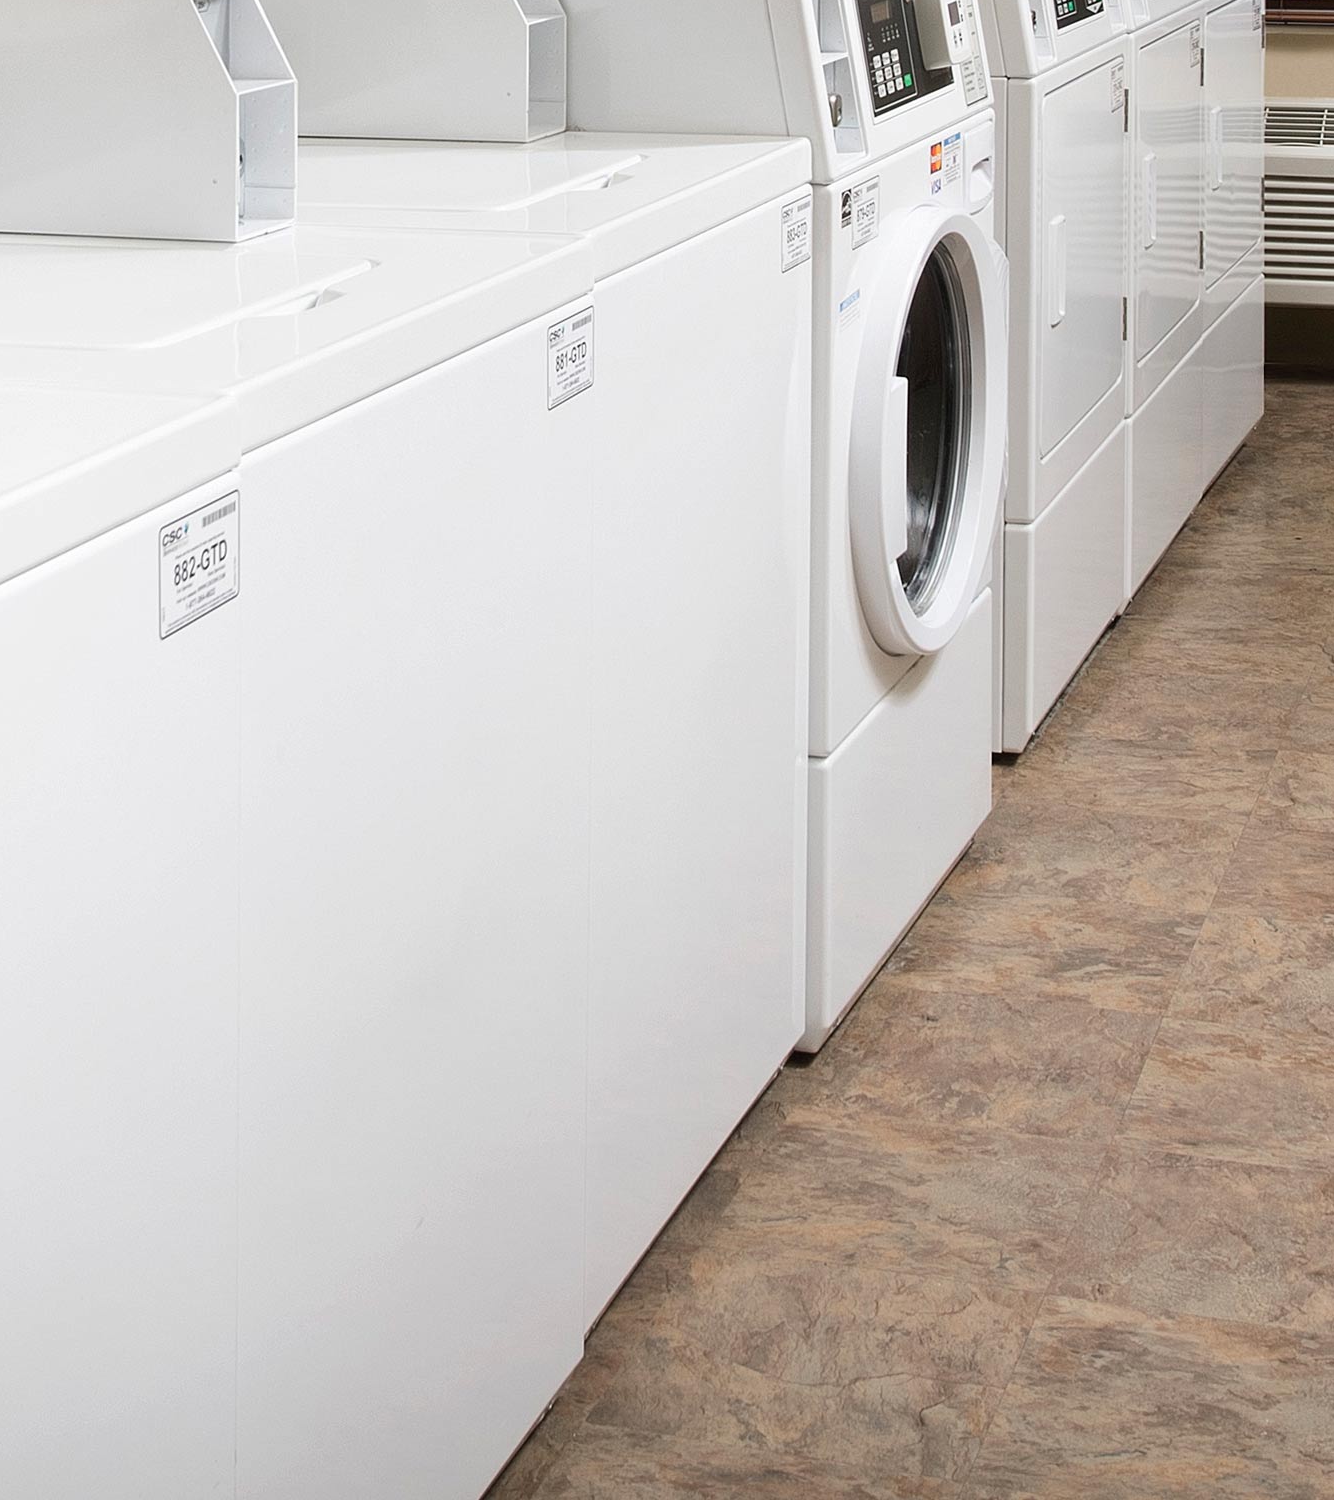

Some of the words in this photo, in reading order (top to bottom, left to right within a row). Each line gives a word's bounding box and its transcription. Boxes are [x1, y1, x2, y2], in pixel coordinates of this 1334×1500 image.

[555, 342, 587, 372] 881-GTD
[162, 527, 182, 547] CSC
[174, 539, 227, 586] 882-GTD
